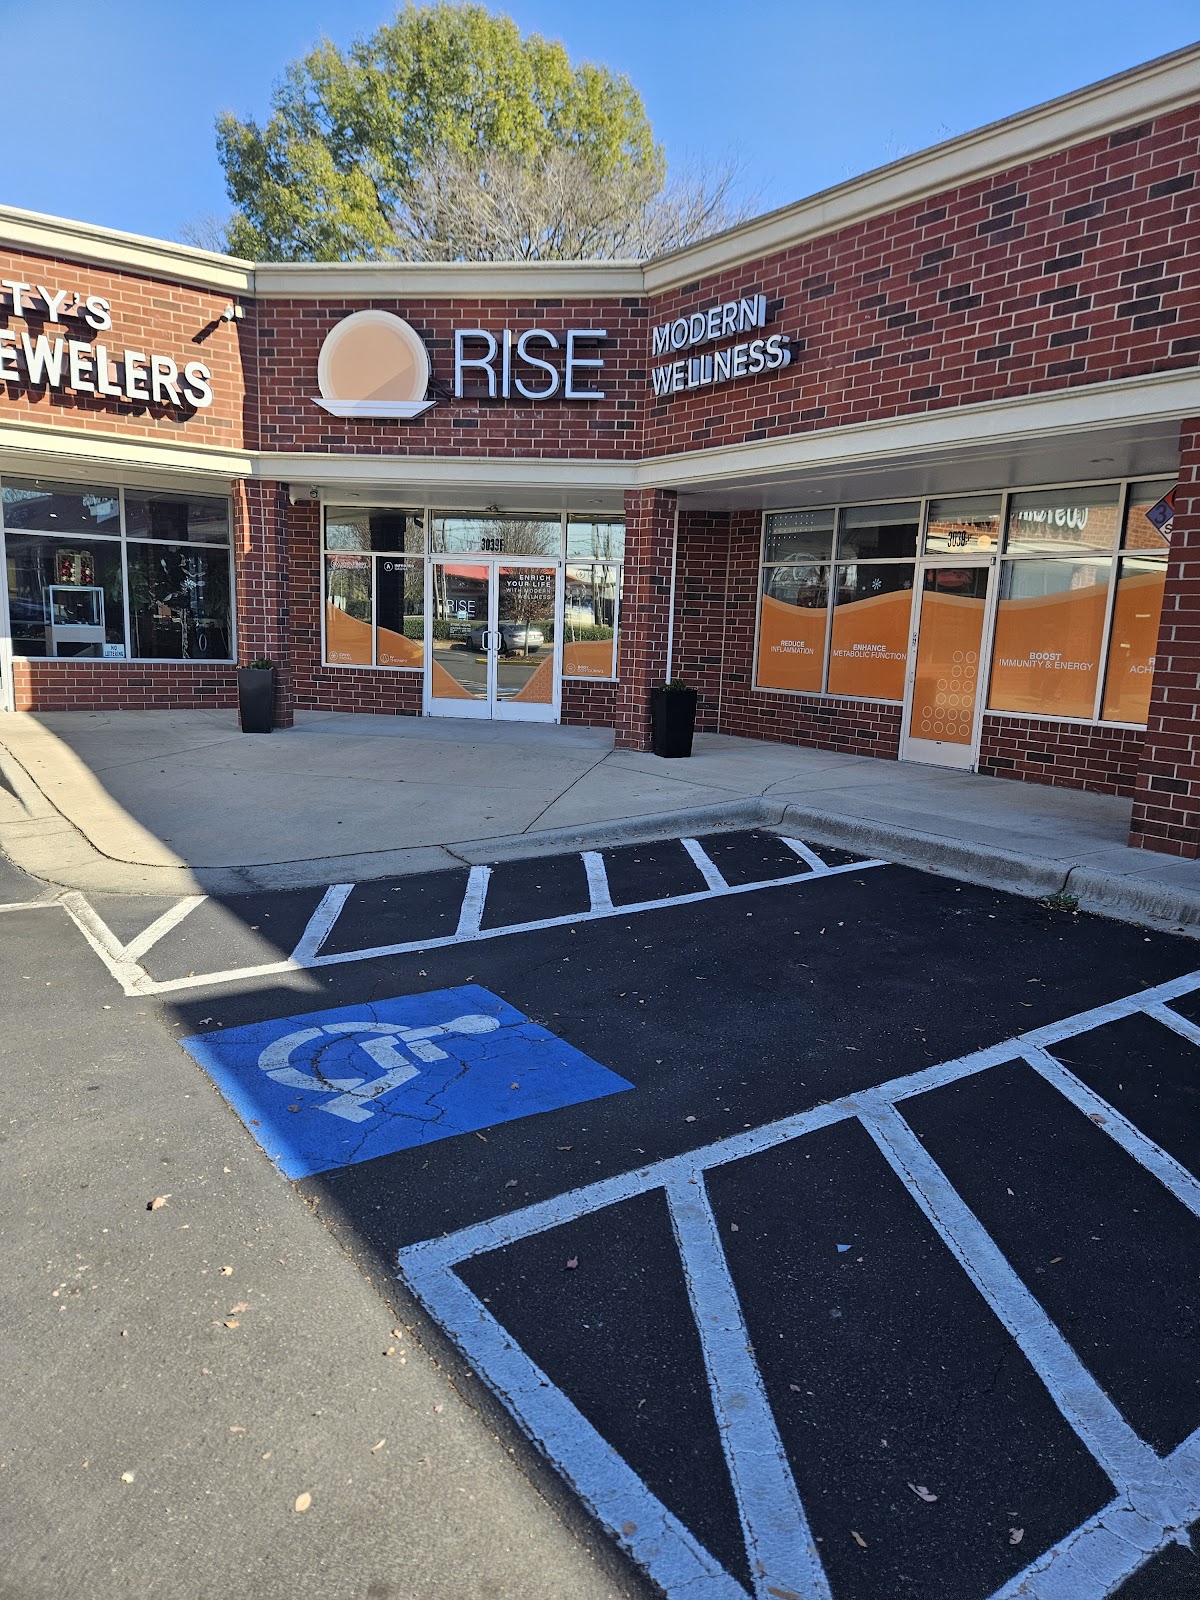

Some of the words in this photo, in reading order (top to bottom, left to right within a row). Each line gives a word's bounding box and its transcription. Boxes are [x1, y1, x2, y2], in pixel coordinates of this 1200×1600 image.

[2, 279, 112, 331] TY'S
[652, 294, 766, 357] MODERN
[0, 328, 213, 408] EWELERS
[454, 329, 607, 400] RISE
[651, 334, 792, 396] WELLNESS
[1154, 504, 1167, 524] 3
[446, 599, 476, 613] RISE
[770, 646, 815, 655] INFLAMMATION
[780, 640, 805, 648] REDUCE
[852, 643, 886, 652] ENHANCE
[832, 649, 871, 659] METABOLIC
[870, 651, 907, 661] FUNCTION
[1029, 652, 1062, 661] BOOST
[998, 659, 1043, 669] IMMUNITY
[1044, 660, 1053, 669] &
[1054, 661, 1094, 671] ENERGY
